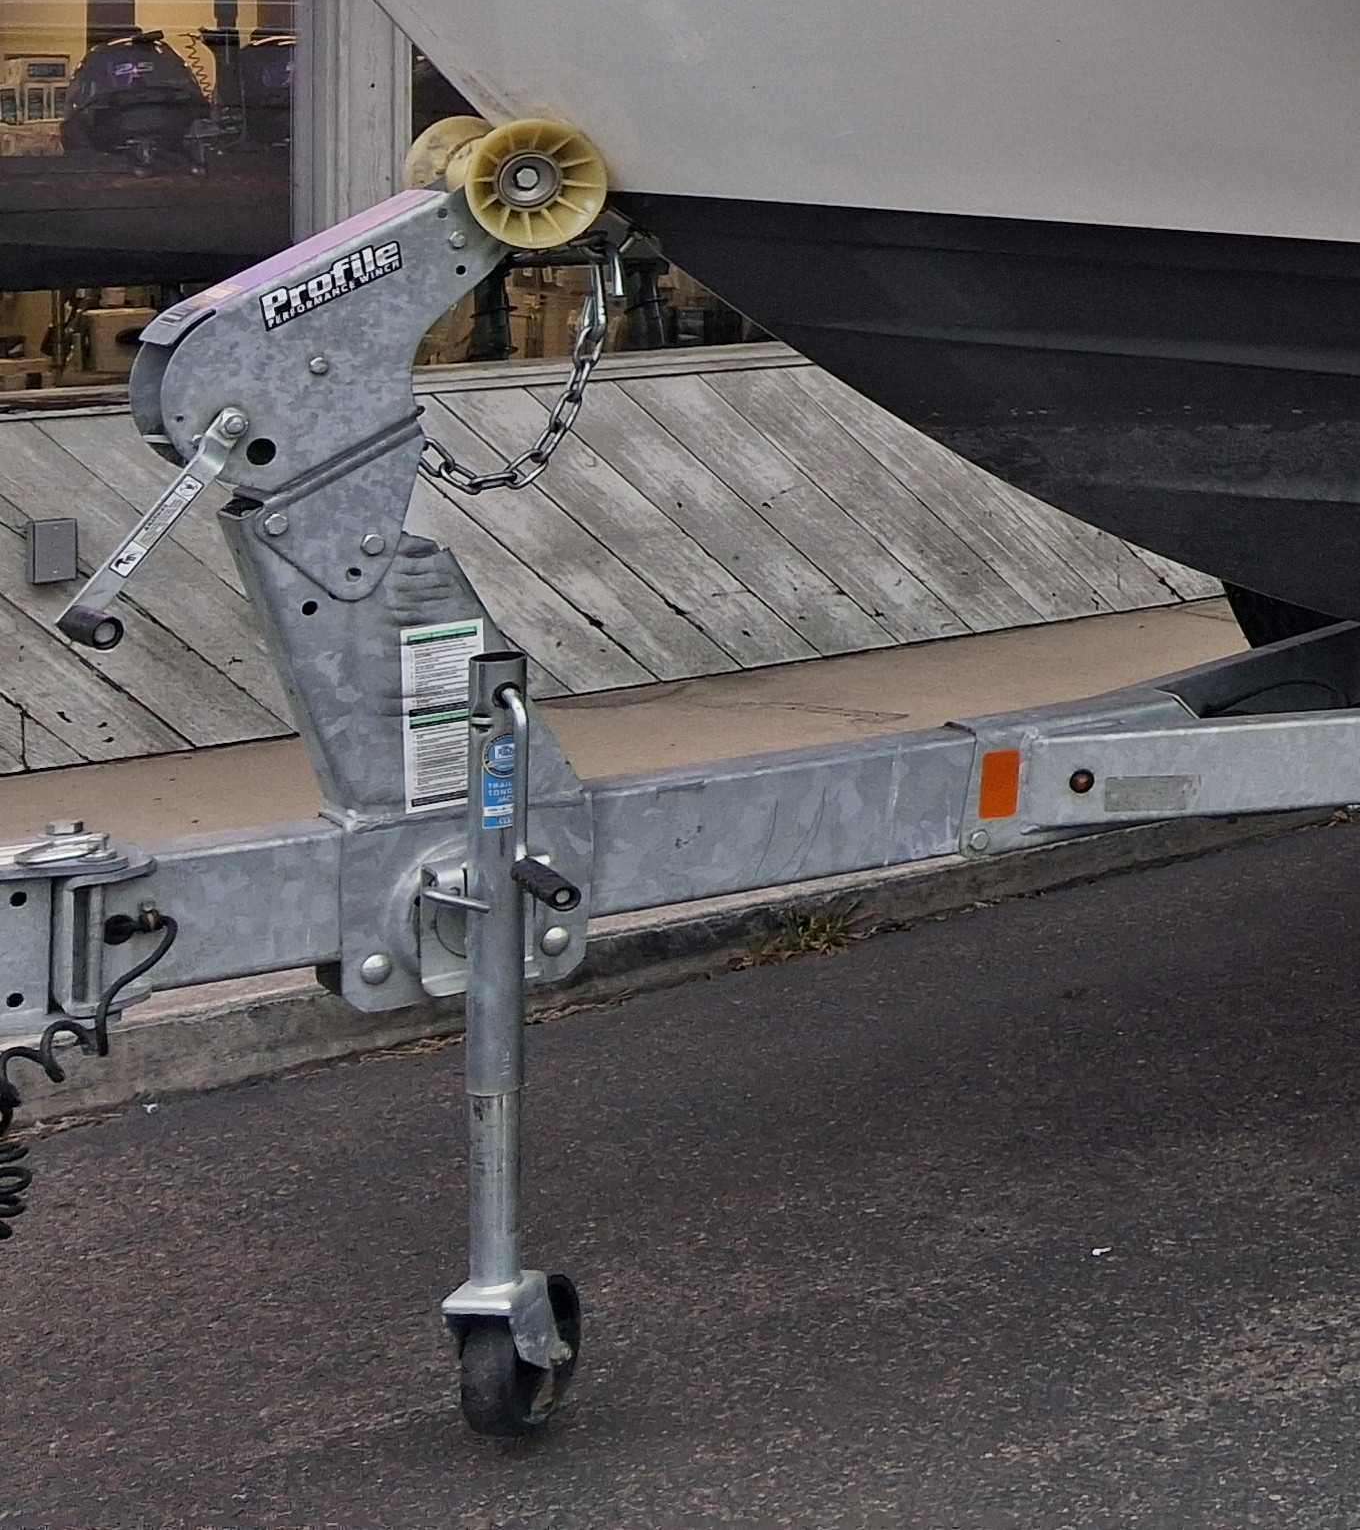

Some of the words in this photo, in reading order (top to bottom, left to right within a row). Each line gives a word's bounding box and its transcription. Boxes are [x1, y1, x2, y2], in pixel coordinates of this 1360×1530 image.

[261, 242, 400, 320] Profile
[268, 281, 356, 328] PERFORMANCE
[361, 259, 401, 284] WINCH
